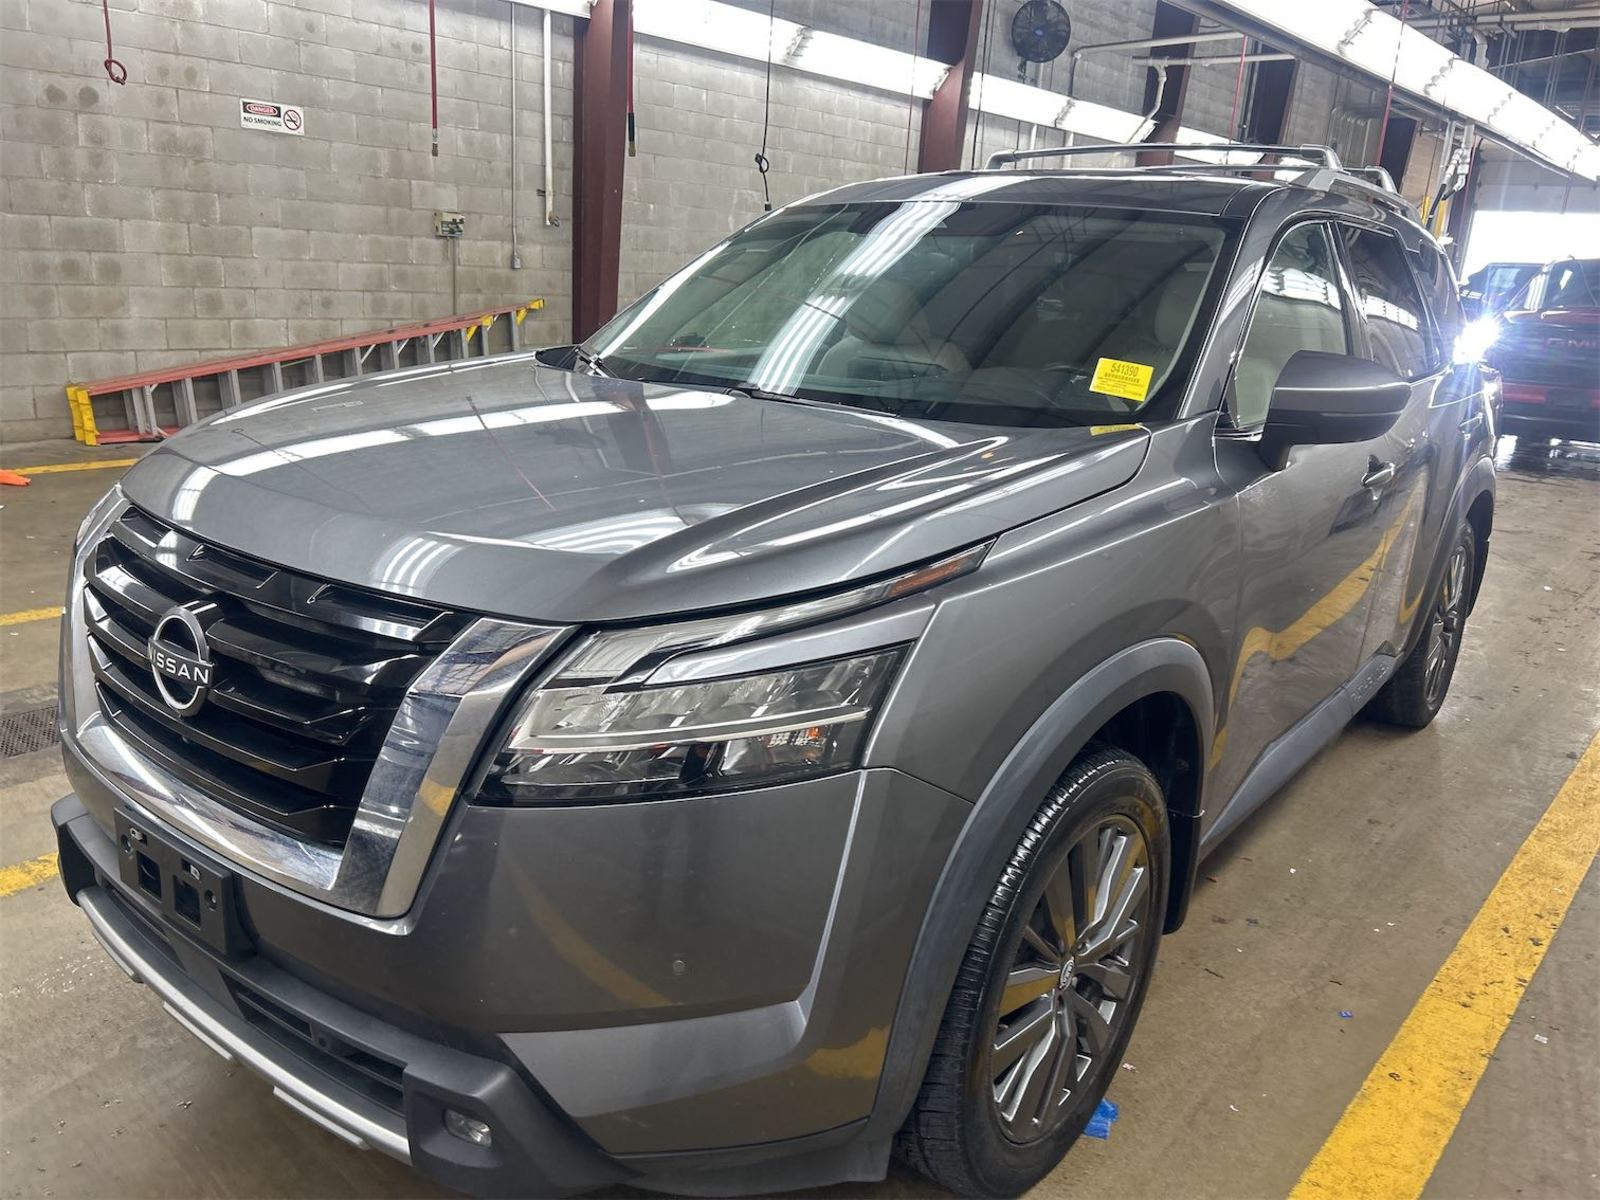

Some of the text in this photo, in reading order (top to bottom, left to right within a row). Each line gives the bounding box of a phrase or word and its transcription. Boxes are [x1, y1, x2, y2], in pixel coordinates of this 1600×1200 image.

[250, 105, 275, 114] DANGER
[254, 118, 282, 127] SMOKING
[1110, 362, 1140, 377] 541390
[149, 645, 209, 684] NISSAN
